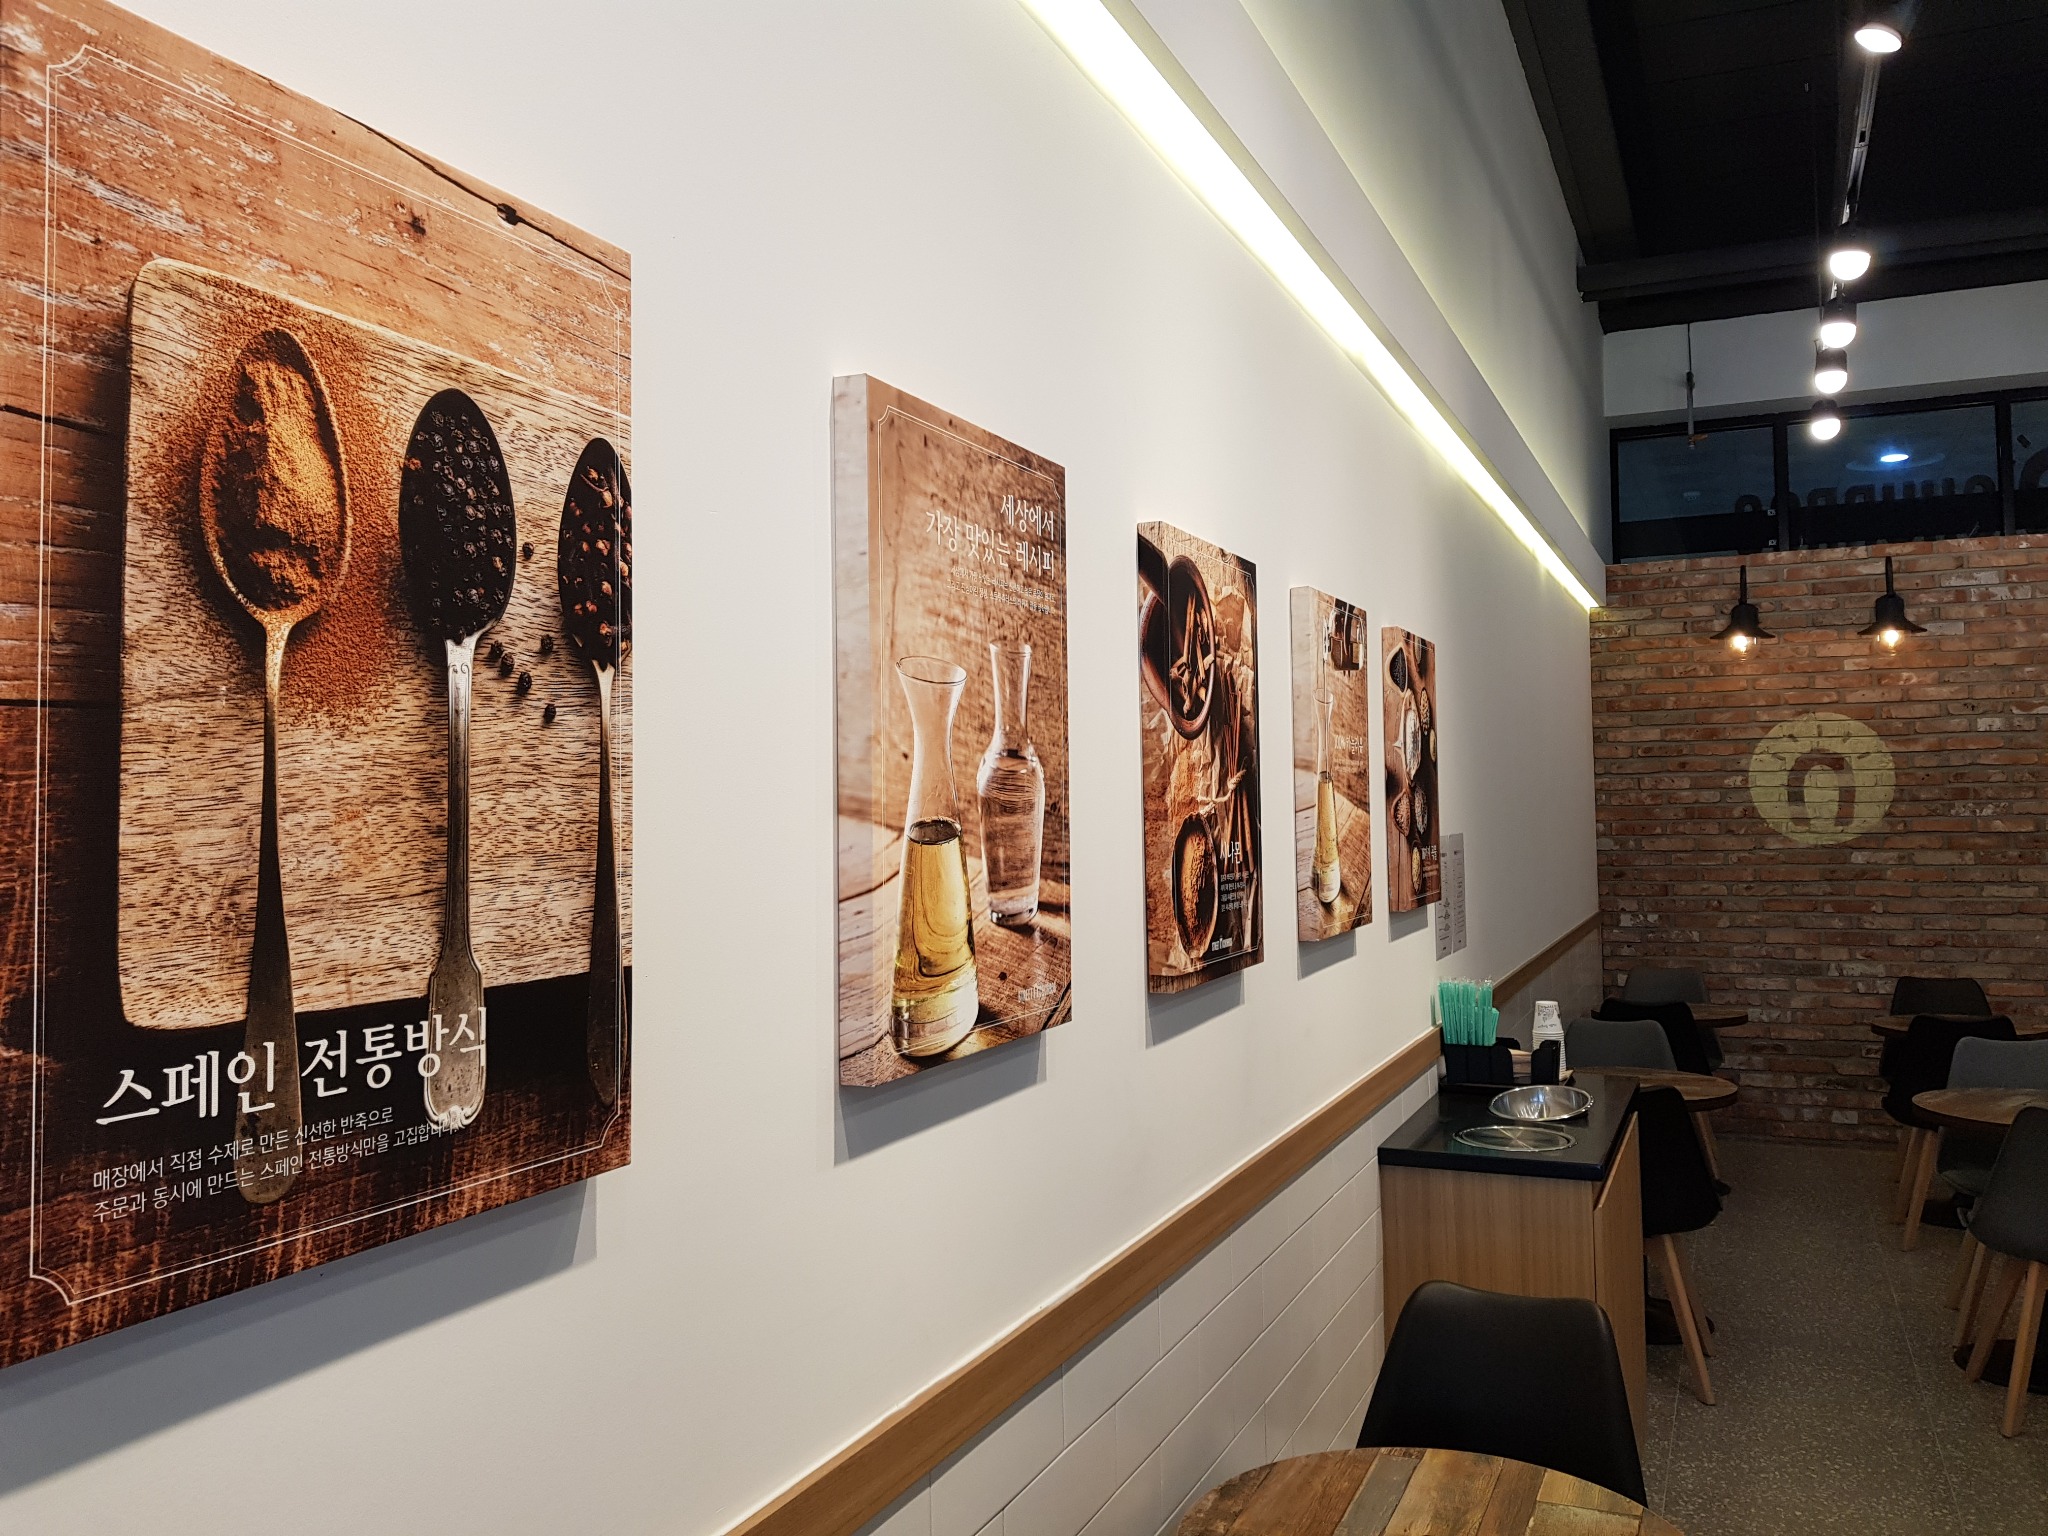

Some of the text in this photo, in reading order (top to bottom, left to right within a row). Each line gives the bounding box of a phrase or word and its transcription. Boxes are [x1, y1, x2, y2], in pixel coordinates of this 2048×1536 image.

[925, 509, 1055, 580] 가장 맛있는 레시피
[1000, 494, 1055, 541] 세상에서
[95, 1006, 487, 1126] 스페인 전통방식
[92, 1191, 148, 1223] 주문과
[151, 1177, 203, 1210] 동시에
[207, 1167, 256, 1196] 만드는
[259, 1153, 304, 1181] 스페인
[308, 1133, 390, 1170] 전통방식만을
[93, 1106, 394, 1191] 매장에서 직접 수제로 만든 신선한 반죽으로
